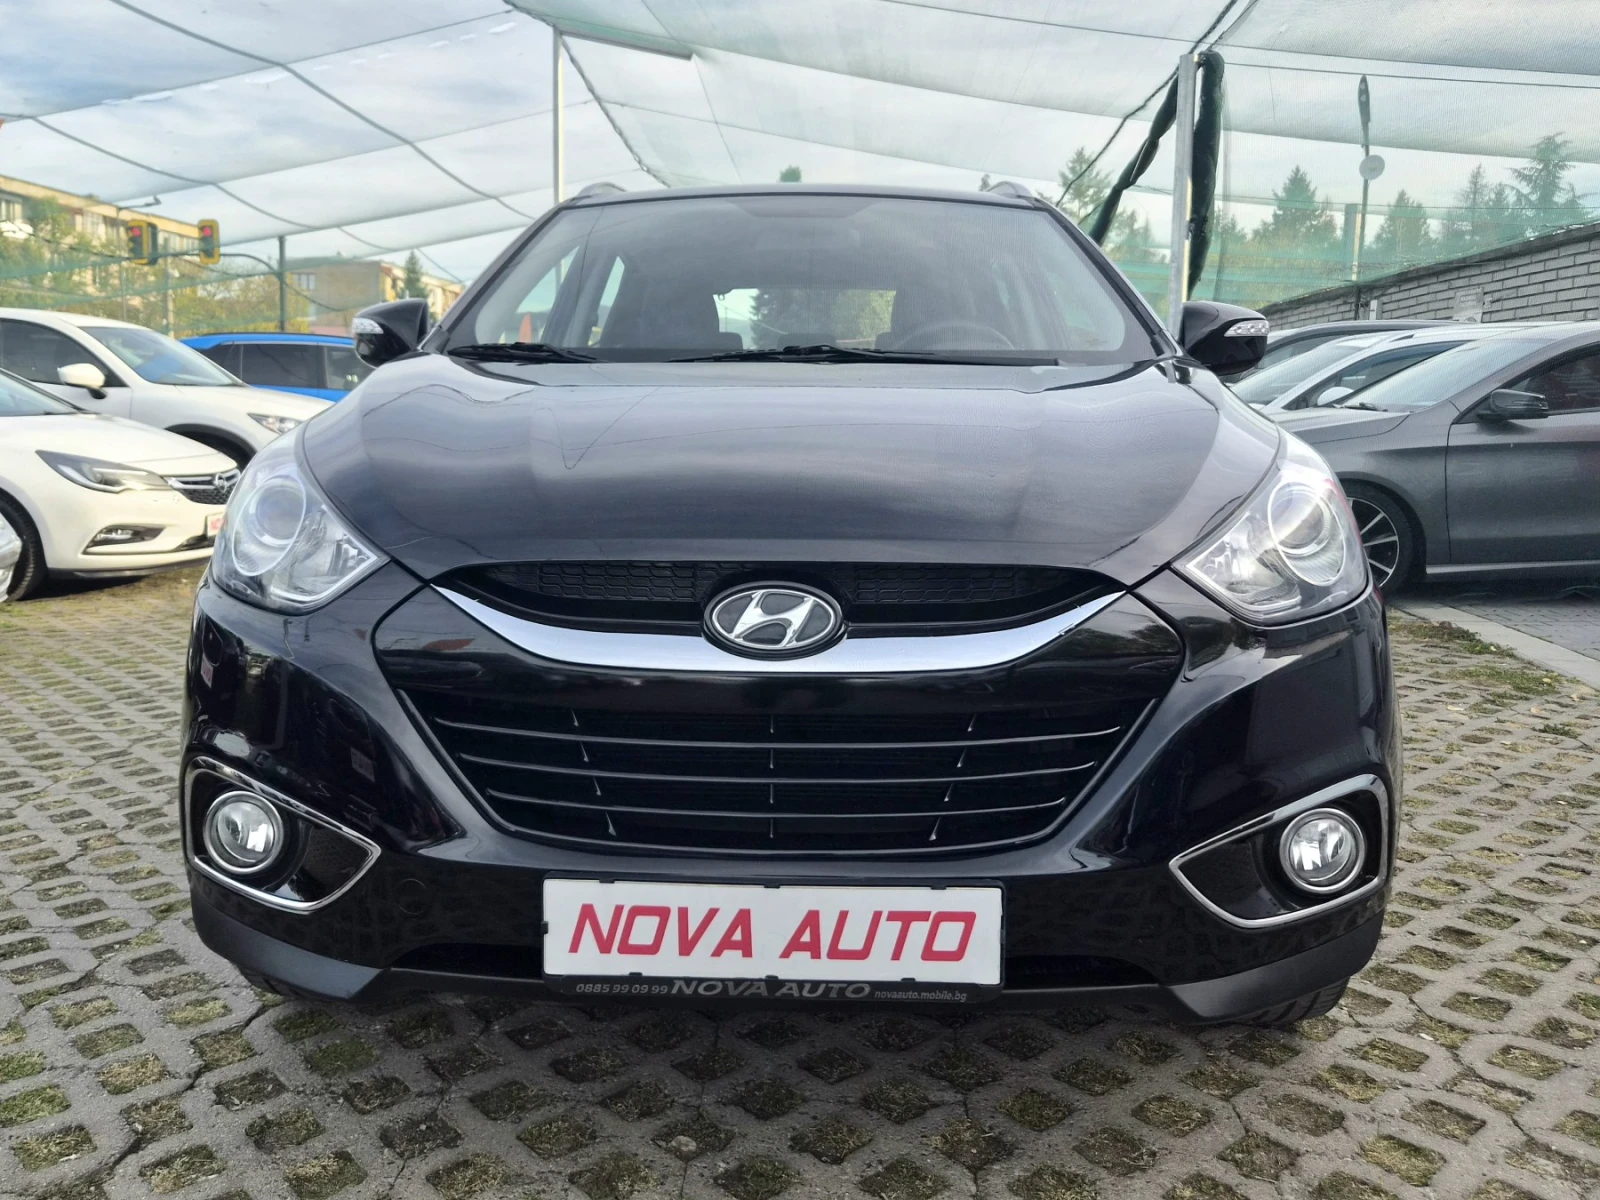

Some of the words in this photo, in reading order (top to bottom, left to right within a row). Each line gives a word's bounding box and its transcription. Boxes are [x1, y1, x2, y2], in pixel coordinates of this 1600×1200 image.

[568, 903, 753, 958] NOVA
[779, 909, 976, 962] AUTO
[576, 983, 610, 993] 0885
[612, 984, 629, 993] 99
[631, 984, 648, 994] 09
[651, 985, 668, 994] 99
[671, 979, 769, 996] NOVA
[775, 982, 871, 998] AUTO
[874, 990, 967, 1002] novaauto.mobile.bg
